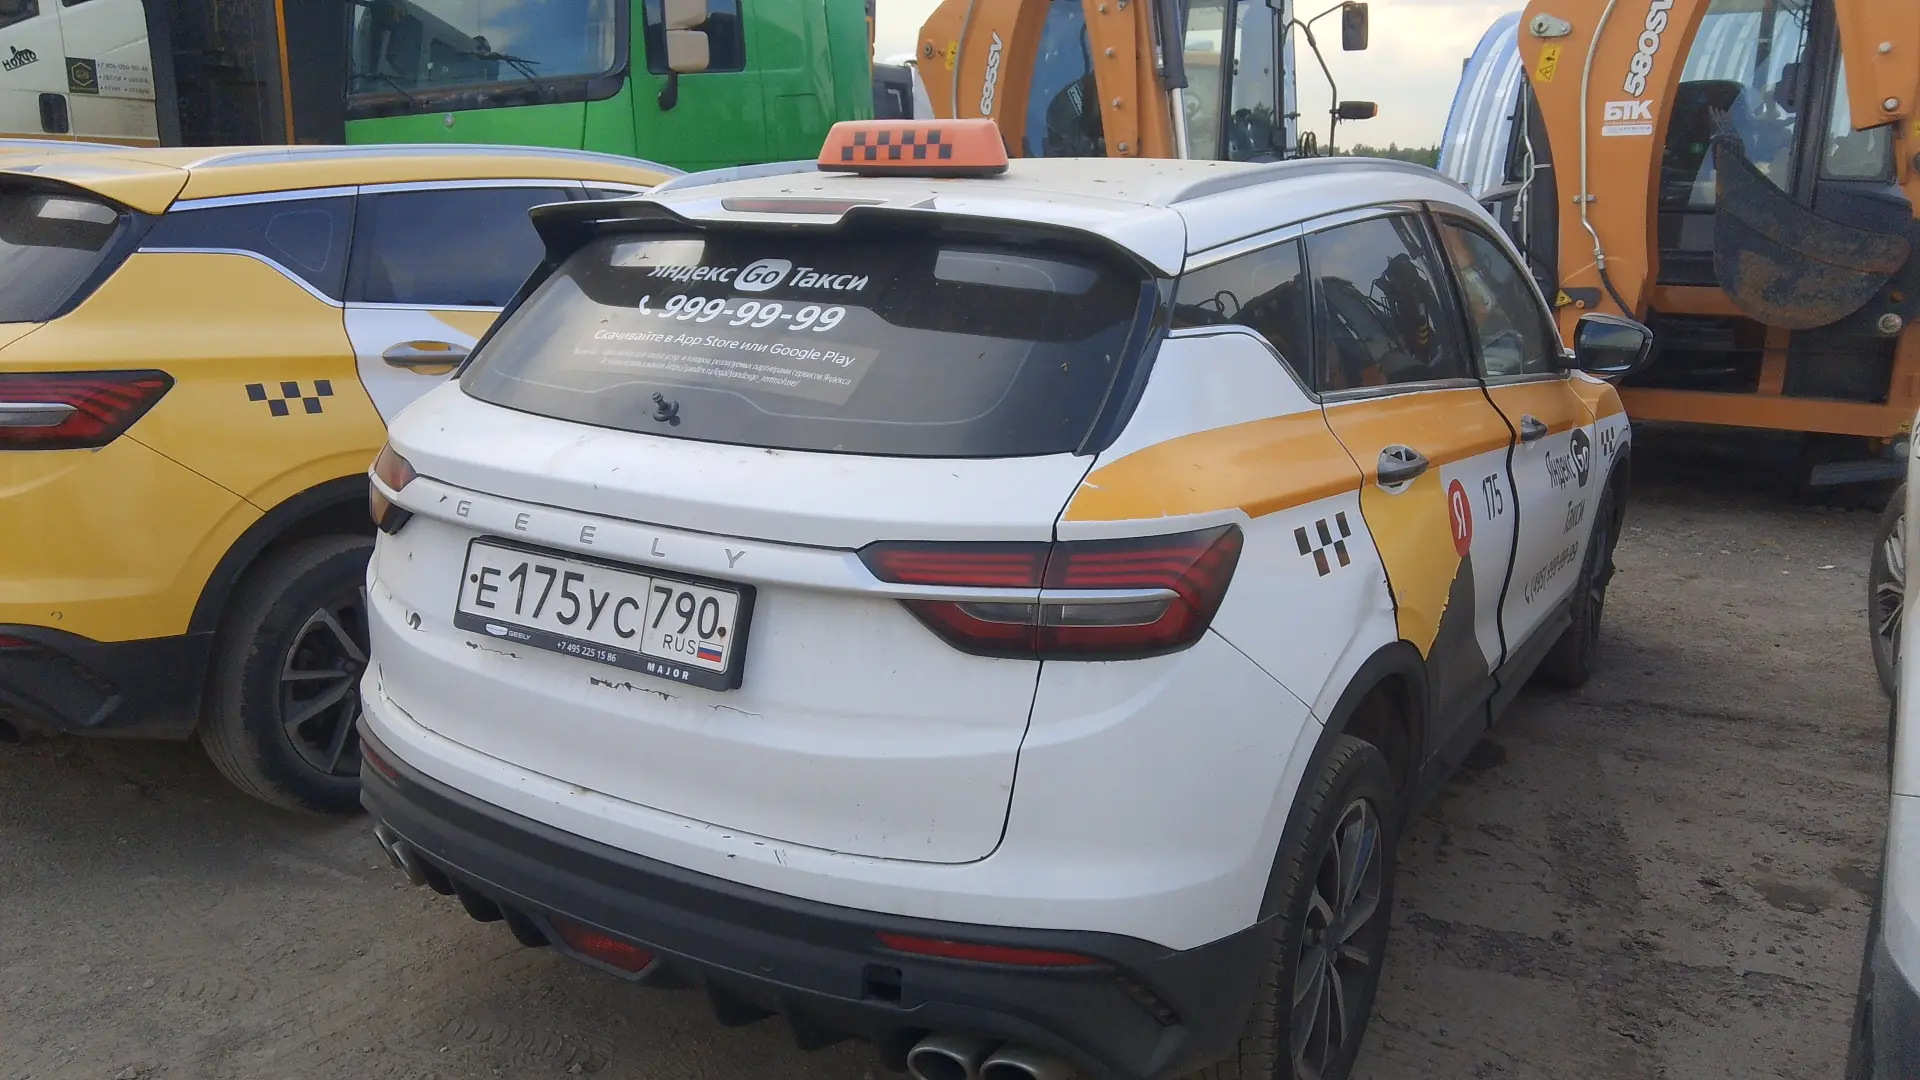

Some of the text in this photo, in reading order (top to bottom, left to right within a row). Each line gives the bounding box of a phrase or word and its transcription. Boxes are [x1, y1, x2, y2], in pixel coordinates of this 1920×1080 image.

[980, 30, 1003, 116] 695SV
[1604, 100, 1654, 121] БТК
[647, 263, 869, 291] Яндекс Go Такси
[658, 295, 846, 332] 999-99-99
[594, 329, 856, 368] Скачивайте в App Store или Google Play
[1545, 439, 1589, 489] Яндекс Go
[1482, 473, 1503, 520] 175
[456, 500, 746, 569] GEELY
[1563, 499, 1586, 534] Такси
[652, 585, 720, 640] 790
[508, 629, 532, 641] GEELY
[557, 640, 617, 663] +7 495 225 15 86
[662, 634, 697, 655] RUS
[647, 661, 689, 681] MAJOR
